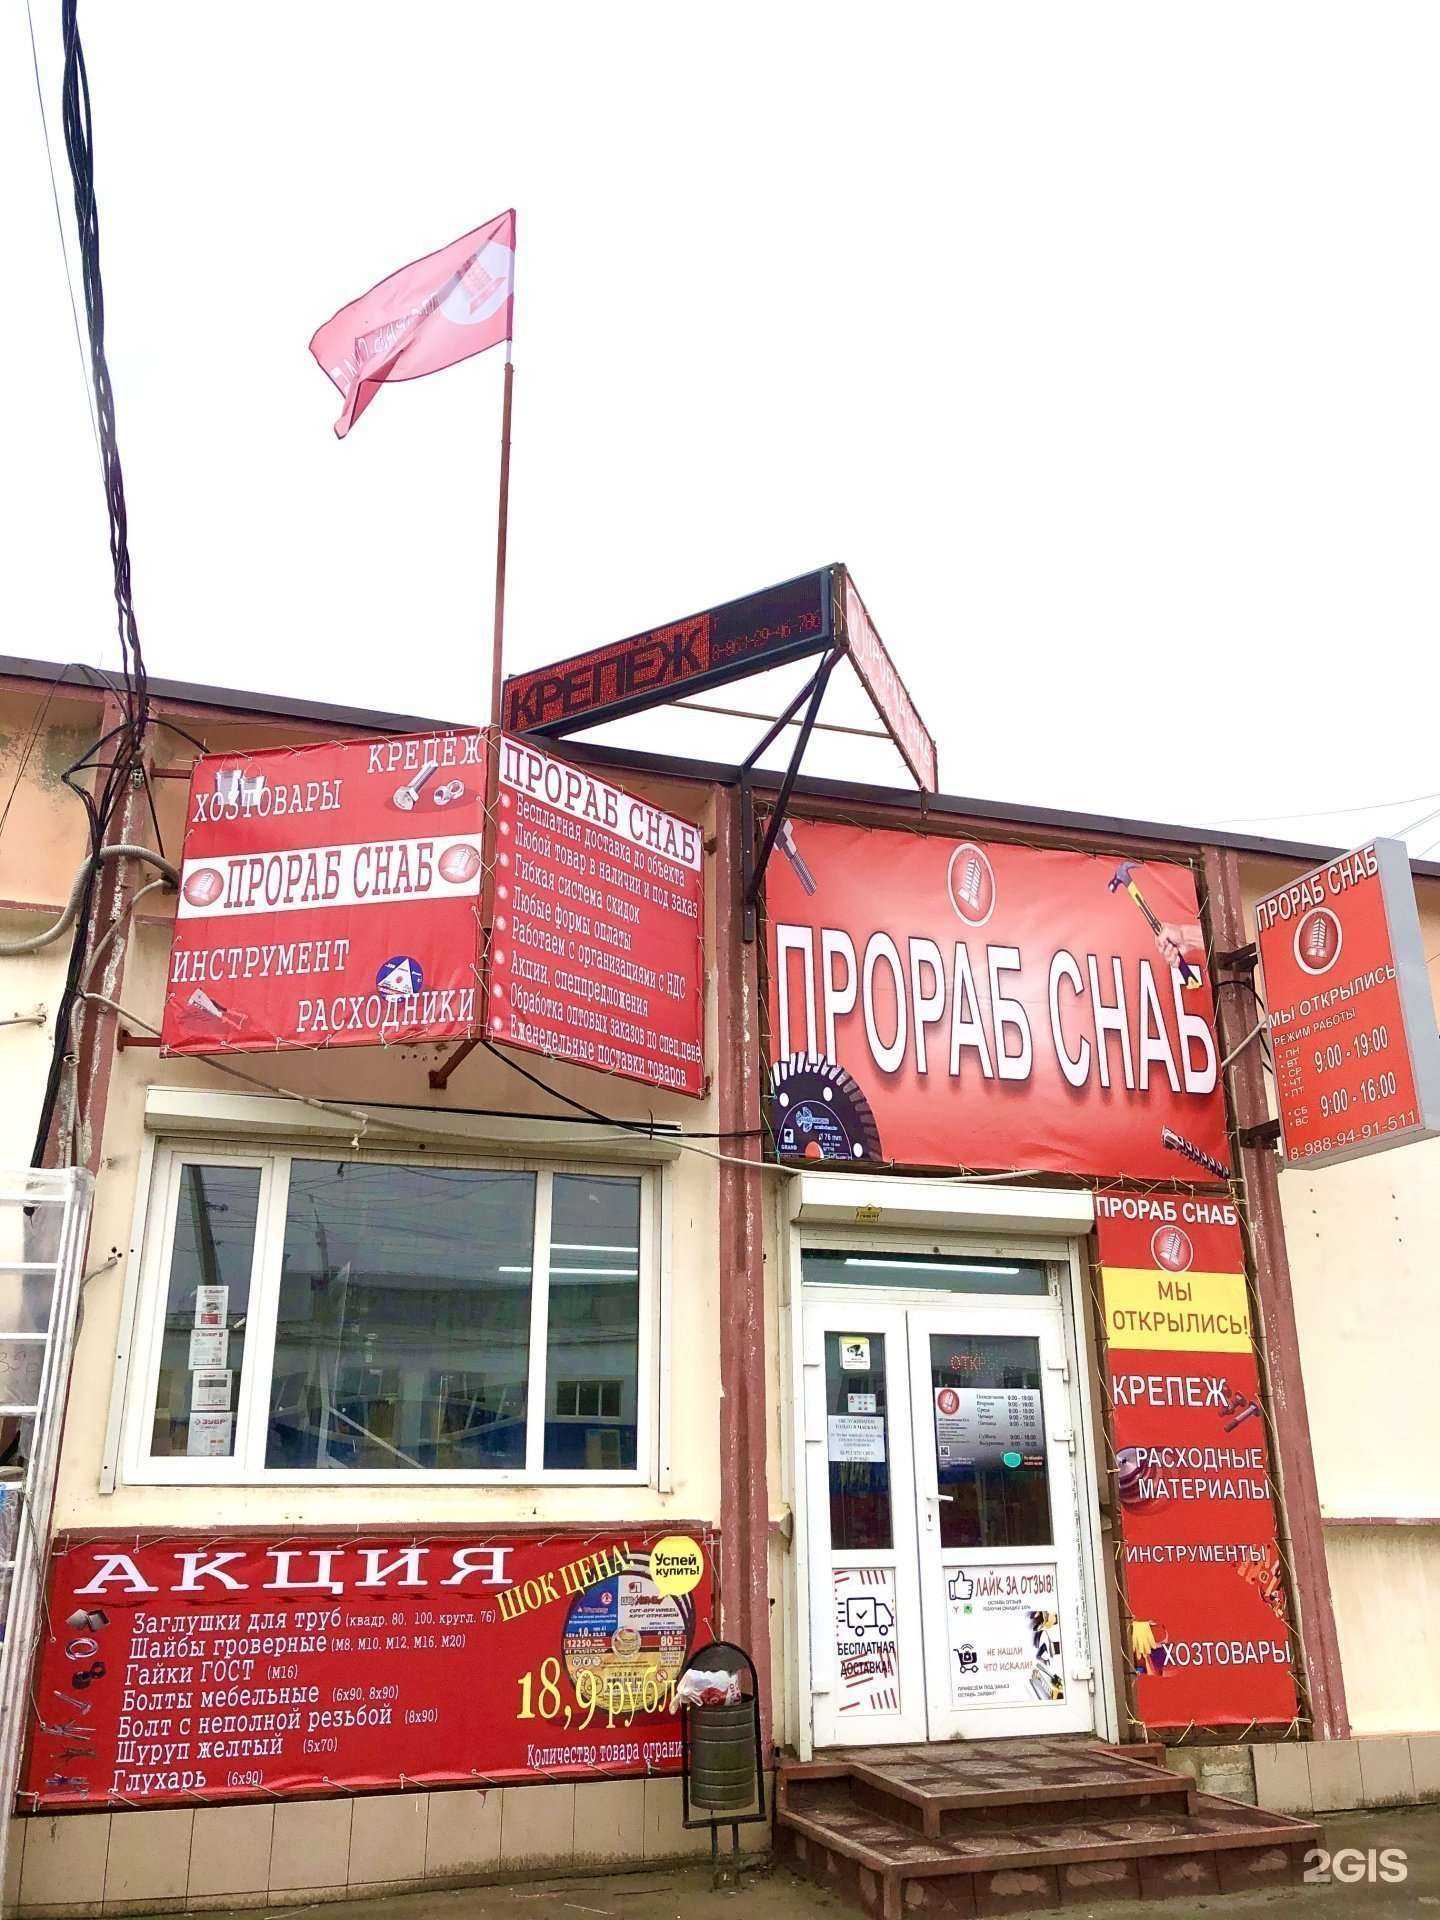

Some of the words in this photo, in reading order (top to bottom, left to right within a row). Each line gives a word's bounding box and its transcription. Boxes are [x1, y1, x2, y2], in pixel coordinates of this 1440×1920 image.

[367, 731, 483, 774] КРЕПЁЖ
[192, 779, 343, 823] ХОЗТОВАРЫ
[504, 743, 618, 828] ПРОРАБ
[629, 803, 695, 864] СНАБ
[517, 792, 581, 842] Бесплатная
[585, 827, 631, 864] доставка
[634, 850, 644, 870] до
[647, 855, 685, 887] объекта
[224, 850, 342, 909] ПРОРАБ
[353, 842, 434, 898] СНАБ
[515, 822, 551, 858] Любой
[555, 843, 586, 877] товар
[590, 857, 596, 875] в
[600, 862, 642, 894] наличии
[643, 883, 650, 903] и
[653, 887, 668, 911] под
[672, 895, 698, 919] заказ
[514, 853, 555, 891] Гибкая
[558, 876, 603, 908] система
[606, 894, 640, 924] скидок
[1256, 873, 1325, 932] ПРОРАБ
[1327, 845, 1379, 895] СНАБ
[513, 886, 551, 921] Любые
[555, 901, 590, 935] формы
[594, 921, 631, 951] оплаты
[171, 939, 350, 983] ИНСТРУМЕНТ
[512, 916, 565, 957] Работаем
[569, 942, 574, 959] с
[579, 944, 656, 989] организациями
[659, 974, 664, 991] с
[667, 972, 686, 1000] НДС
[511, 950, 551, 986] Акции,
[555, 969, 648, 1017] спецпредложения
[1269, 1005, 1295, 1029] МЫ
[1300, 964, 1396, 1016] ОТКРЫЛИСЬ
[296, 988, 475, 1033] РАСХОДНИКИ
[510, 983, 563, 1022] Обработка
[567, 1004, 608, 1035] оптовых
[610, 1017, 644, 1046] заказов
[647, 1030, 657, 1050] по
[775, 922, 1034, 1081] ПРОРАБ
[1047, 948, 1218, 1095] СНАБ
[1274, 1026, 1311, 1047] РЕЖИМ
[1313, 1008, 1356, 1032] РАБОТЫ
[510, 1014, 595, 1060] Еженедельные
[598, 1044, 645, 1075] поставки
[649, 1060, 686, 1087] товаров
[1286, 1047, 1300, 1057] ПН
[1287, 1058, 1298, 1068] ВТ
[1314, 1044, 1342, 1073] 9:00
[1353, 1024, 1388, 1060] 19:00
[1289, 1067, 1302, 1077] СР
[1289, 1077, 1302, 1086] ЧТ
[1291, 1087, 1304, 1097] ПТ
[1321, 1088, 1348, 1117] 9:00
[1361, 1071, 1396, 1103] 16:00
[1294, 1106, 1308, 1116] СБ
[1295, 1116, 1308, 1127] ВС
[1291, 1110, 1415, 1160] 8-988-94-91-511
[1096, 1196, 1177, 1222] ПРОРАБ
[1182, 1203, 1237, 1226] СНАБ
[1157, 1281, 1193, 1302] МЫ
[1112, 1310, 1249, 1336] ОТКРЫЛИСЬ!
[1112, 1375, 1229, 1408] КРЕПЕЖ
[1135, 1447, 1264, 1472] РАСХОДНЫЕ
[1138, 1478, 1271, 1500] МАТЕРИАЛЫ
[73, 1546, 514, 1595] АКЦИЯ
[654, 1553, 697, 1567] Успей
[1126, 1545, 1266, 1563] ИНСТРУМЕНТЫ
[495, 1571, 561, 1623] ШОК
[558, 1540, 636, 1595] ЦЕНА!
[655, 1566, 700, 1578] купить!
[975, 1571, 1004, 1597] ЛАЙК
[1006, 1576, 1018, 1595] ЗА
[1021, 1575, 1054, 1595] ОТЗЫВ!
[132, 1612, 241, 1638] Заглушки
[248, 1612, 287, 1634] для
[294, 1607, 342, 1634] труб
[480, 1609, 496, 1624] 76)
[129, 1637, 205, 1660] Шайбы
[212, 1633, 327, 1659] гроверные
[661, 1635, 673, 1646] 80
[837, 1641, 894, 1655] БЕСПЛАТНАЯ
[987, 1648, 998, 1656] НЕ
[1000, 1647, 1023, 1655] НАШЛИ
[1162, 1640, 1292, 1667] ХОЗТОВАРЫ
[124, 1663, 193, 1686] Гайки
[200, 1659, 255, 1682] ГОСТ
[122, 1690, 192, 1712] Болты
[200, 1684, 319, 1709] мебельные
[516, 1656, 597, 1731] 18,9
[117, 1716, 172, 1739] Болт
[179, 1718, 191, 1735] с
[198, 1709, 302, 1736] неполной
[307, 1704, 393, 1732] резьбой
[115, 1741, 190, 1768] Шуруп
[196, 1732, 283, 1758] желтый
[526, 1744, 597, 1766] Количество
[600, 1743, 640, 1764] товара
[643, 1739, 682, 1762] ограни
[112, 1768, 206, 1795] Глухарь
